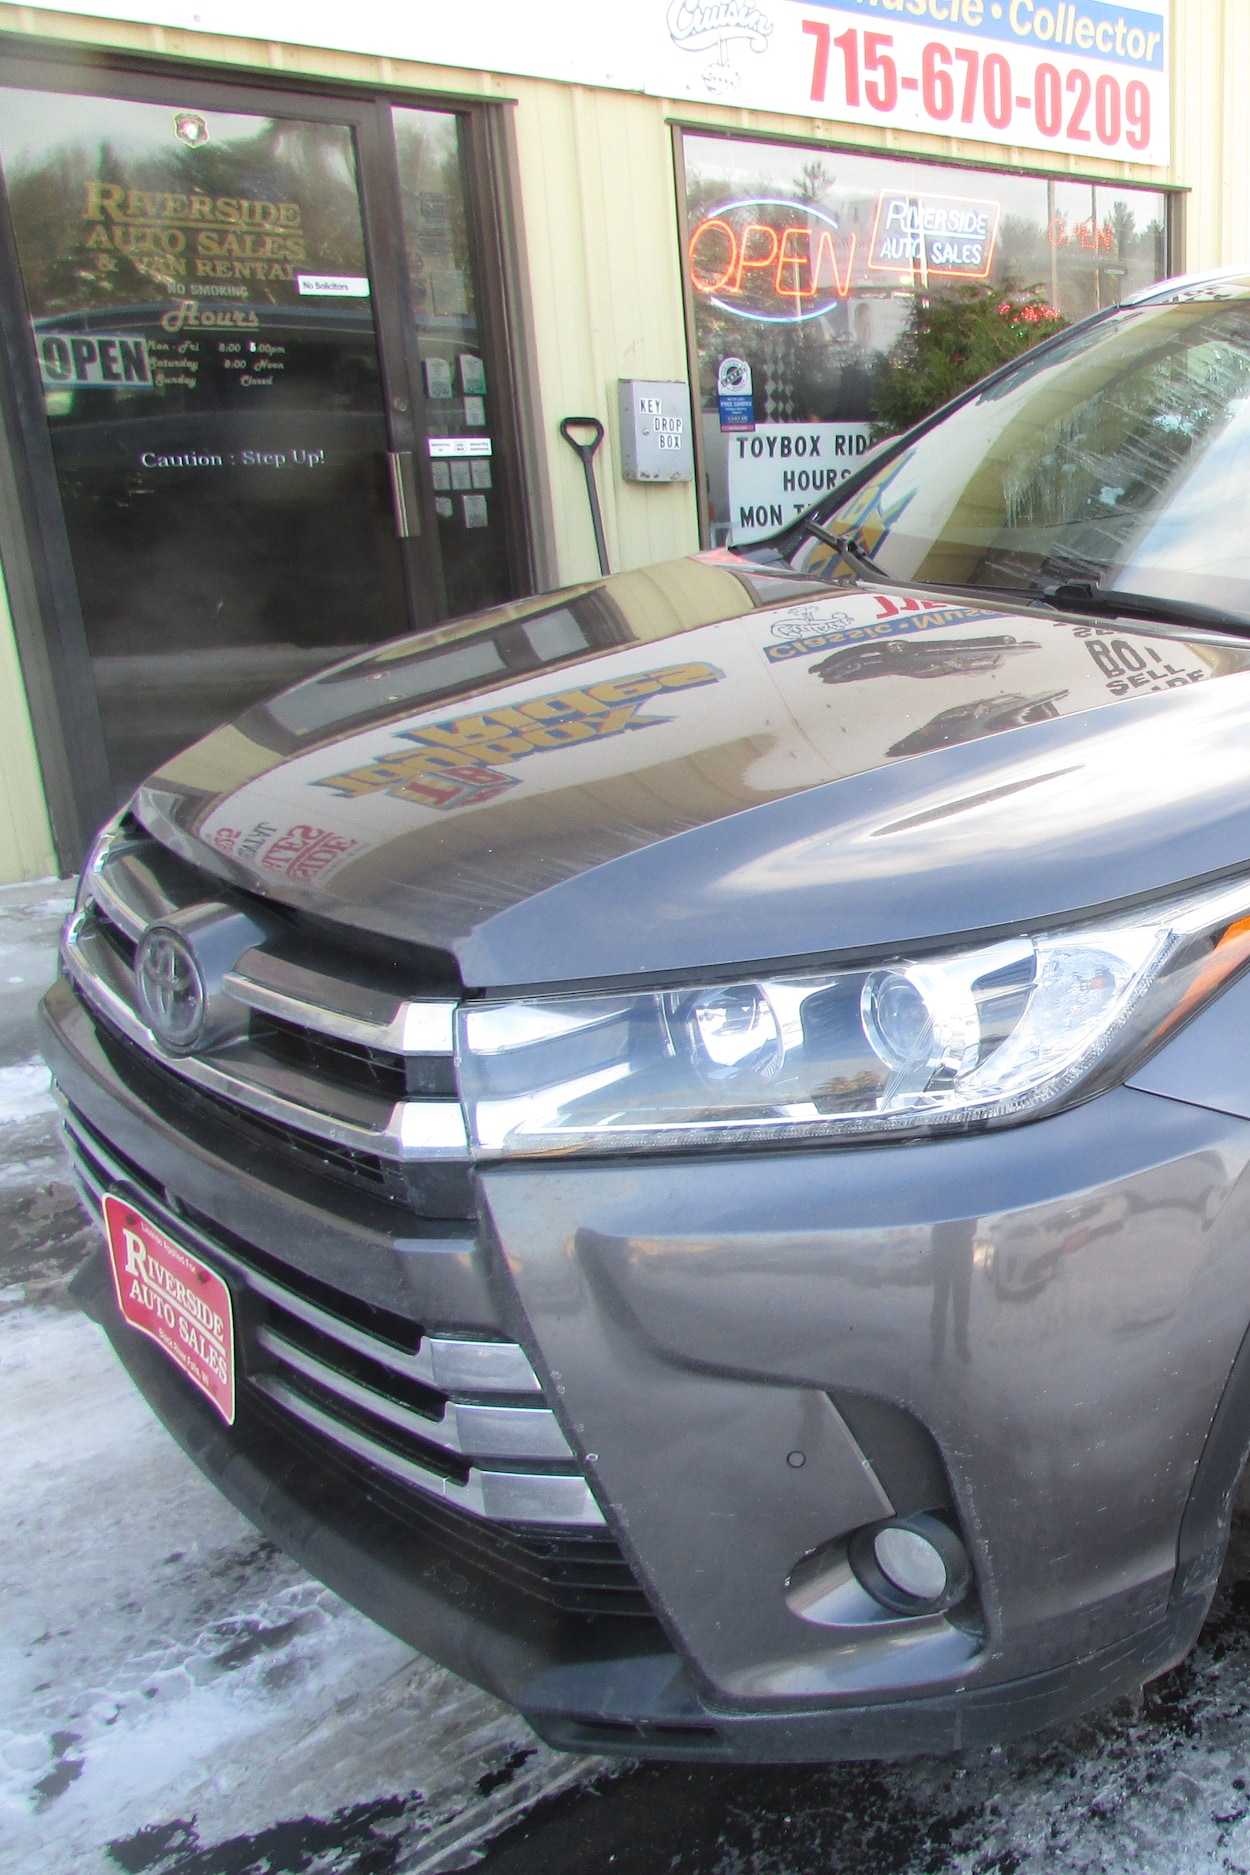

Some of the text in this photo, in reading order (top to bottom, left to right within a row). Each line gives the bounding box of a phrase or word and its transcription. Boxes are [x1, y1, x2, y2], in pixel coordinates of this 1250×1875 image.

[856, 0, 1160, 62] uscle Collector
[802, 19, 1151, 151] 715-670-0209
[83, 181, 302, 228] RIVERSIDE
[885, 201, 989, 235] RIVERSIDE
[86, 225, 307, 261] AUTO SALES
[1047, 217, 1112, 250] OPEN
[689, 219, 857, 298] OPEN
[880, 237, 983, 265] AUTO SALES
[131, 255, 187, 277] VAN
[167, 284, 249, 298] NO SMOKING
[303, 281, 349, 291] No Solicitors
[161, 301, 260, 333] Hours
[40, 336, 149, 382] OPEN
[149, 357, 199, 372] Saturday
[253, 359, 285, 372] Noon
[155, 374, 274, 388] Sunday Closed
[640, 399, 661, 413] KEY
[654, 417, 682, 432] DROP
[659, 434, 680, 449] BOX
[737, 435, 877, 459] TOYBOX RID
[141, 452, 224, 469] Caution
[242, 450, 286, 469] Step
[293, 449, 326, 469] Up!
[740, 504, 783, 528] MON
[123, 1228, 224, 1342] RIVERSIDE
[129, 1279, 228, 1385] AUTO SALES
